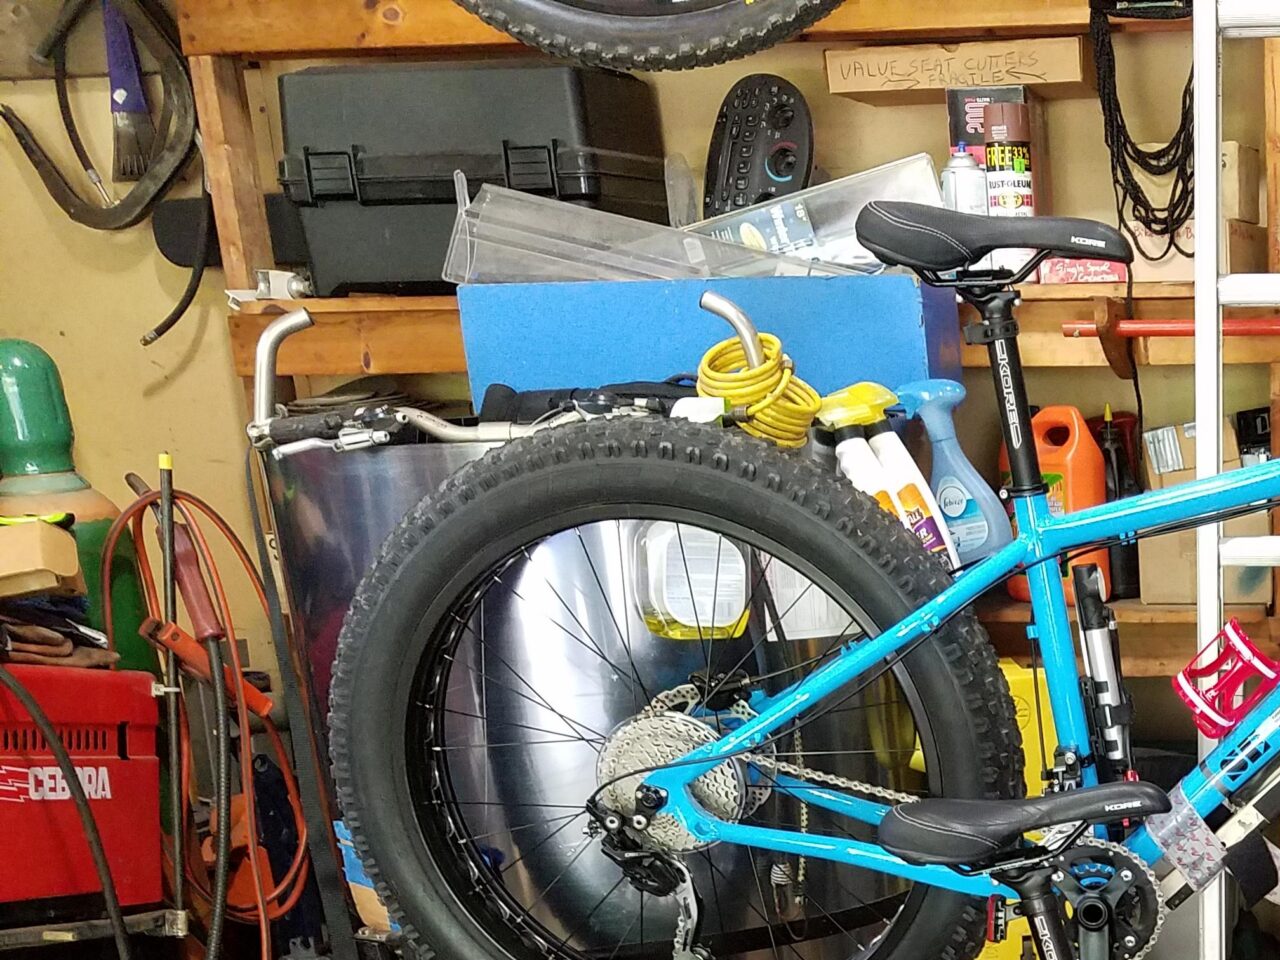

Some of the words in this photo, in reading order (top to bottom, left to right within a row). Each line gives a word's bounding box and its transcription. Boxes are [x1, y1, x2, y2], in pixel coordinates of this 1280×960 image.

[840, 59, 899, 80] VALUE
[910, 56, 953, 76] SEAT
[963, 51, 1040, 72] CUTTERS
[928, 69, 1005, 85] FRAGILE
[986, 146, 1012, 167] FREE
[1012, 146, 1030, 159] 33%
[1070, 235, 1106, 248] KORE
[997, 353, 1021, 436] KORE
[28, 766, 113, 800] CEBRA
[1104, 800, 1143, 813] KORE
